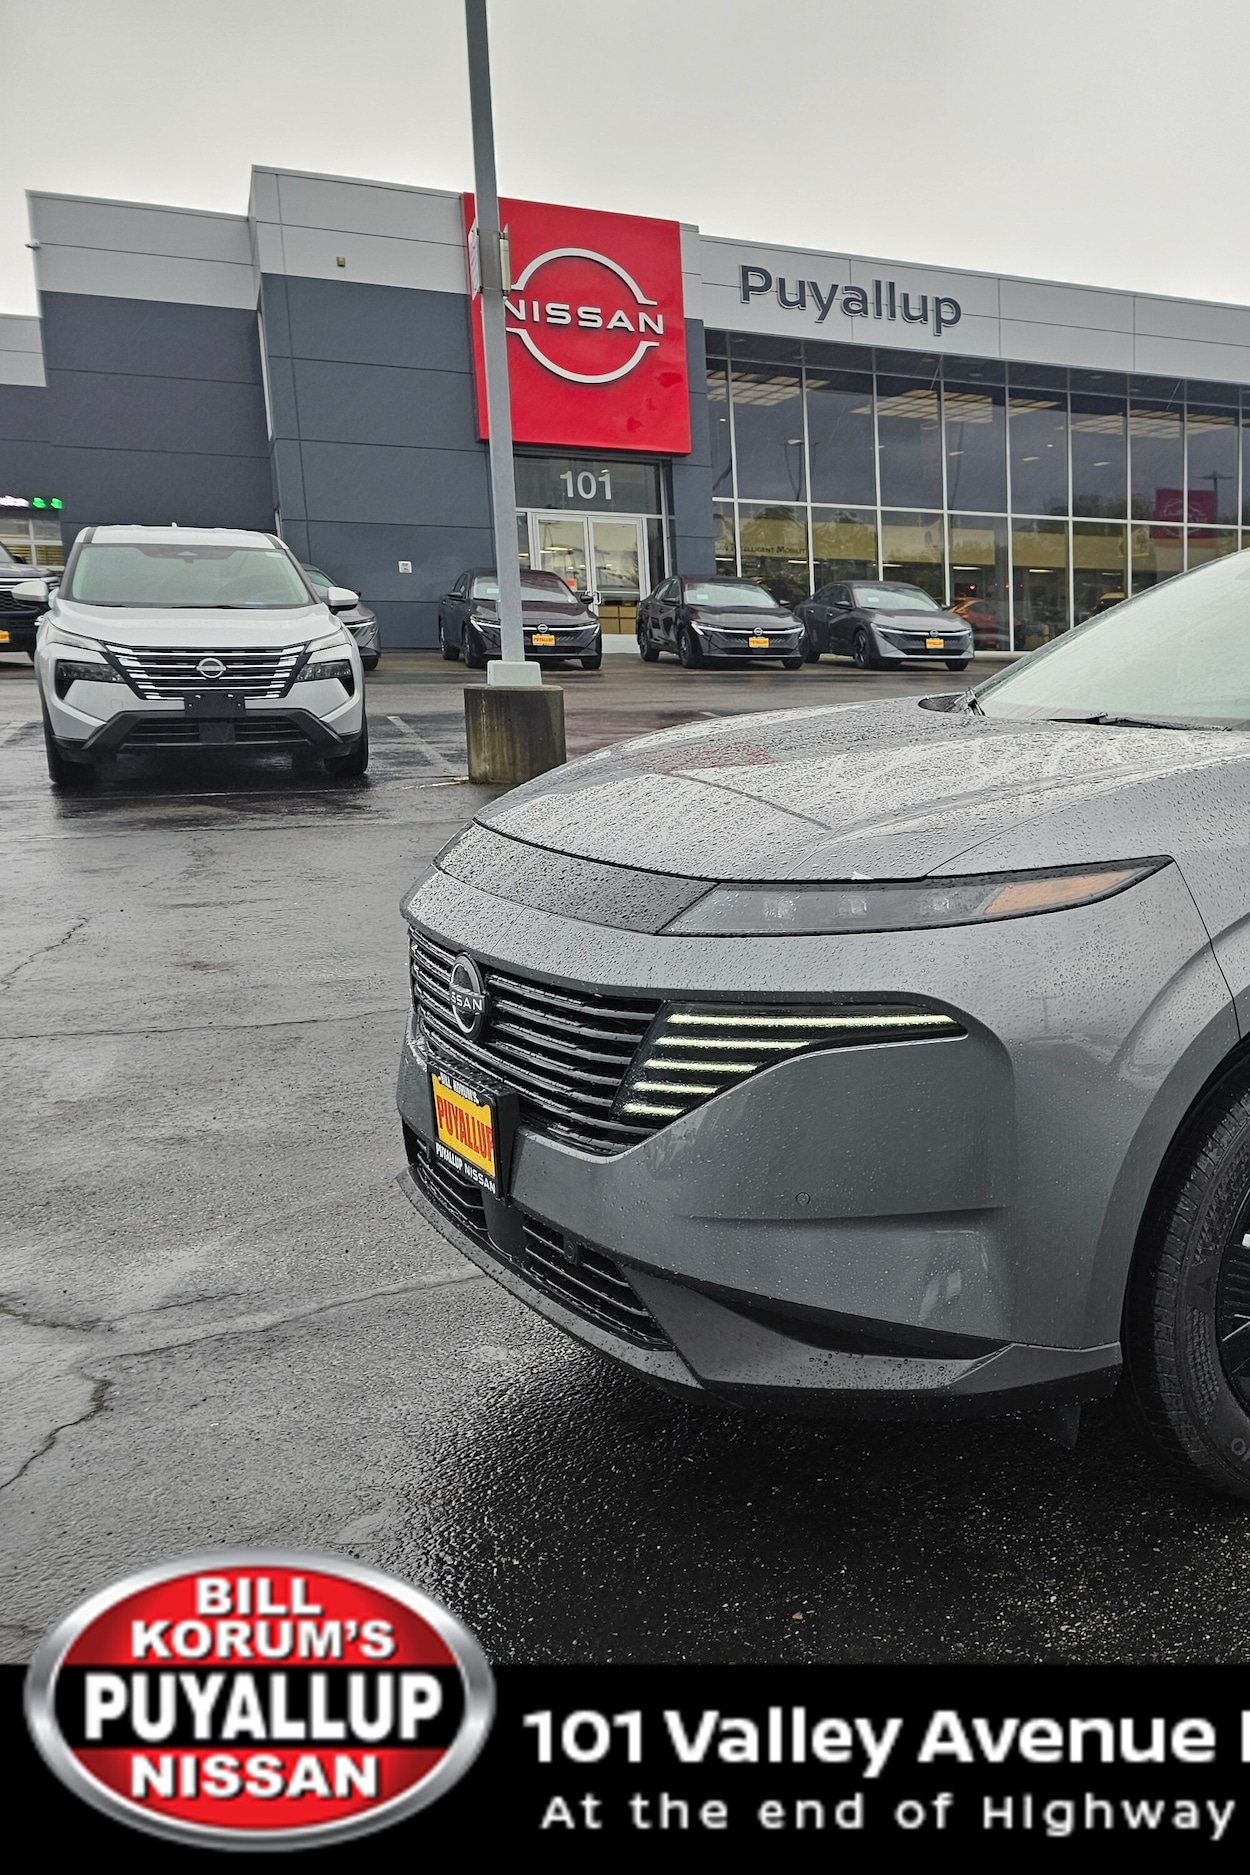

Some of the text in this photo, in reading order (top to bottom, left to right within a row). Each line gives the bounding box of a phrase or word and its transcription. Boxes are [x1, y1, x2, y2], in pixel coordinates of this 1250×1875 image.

[503, 299, 664, 335] NISSAN
[740, 265, 962, 336] Puyallup
[560, 470, 612, 500] 101
[436, 1094, 494, 1162] PUYALLUP
[464, 1162, 496, 1194] NISSAN
